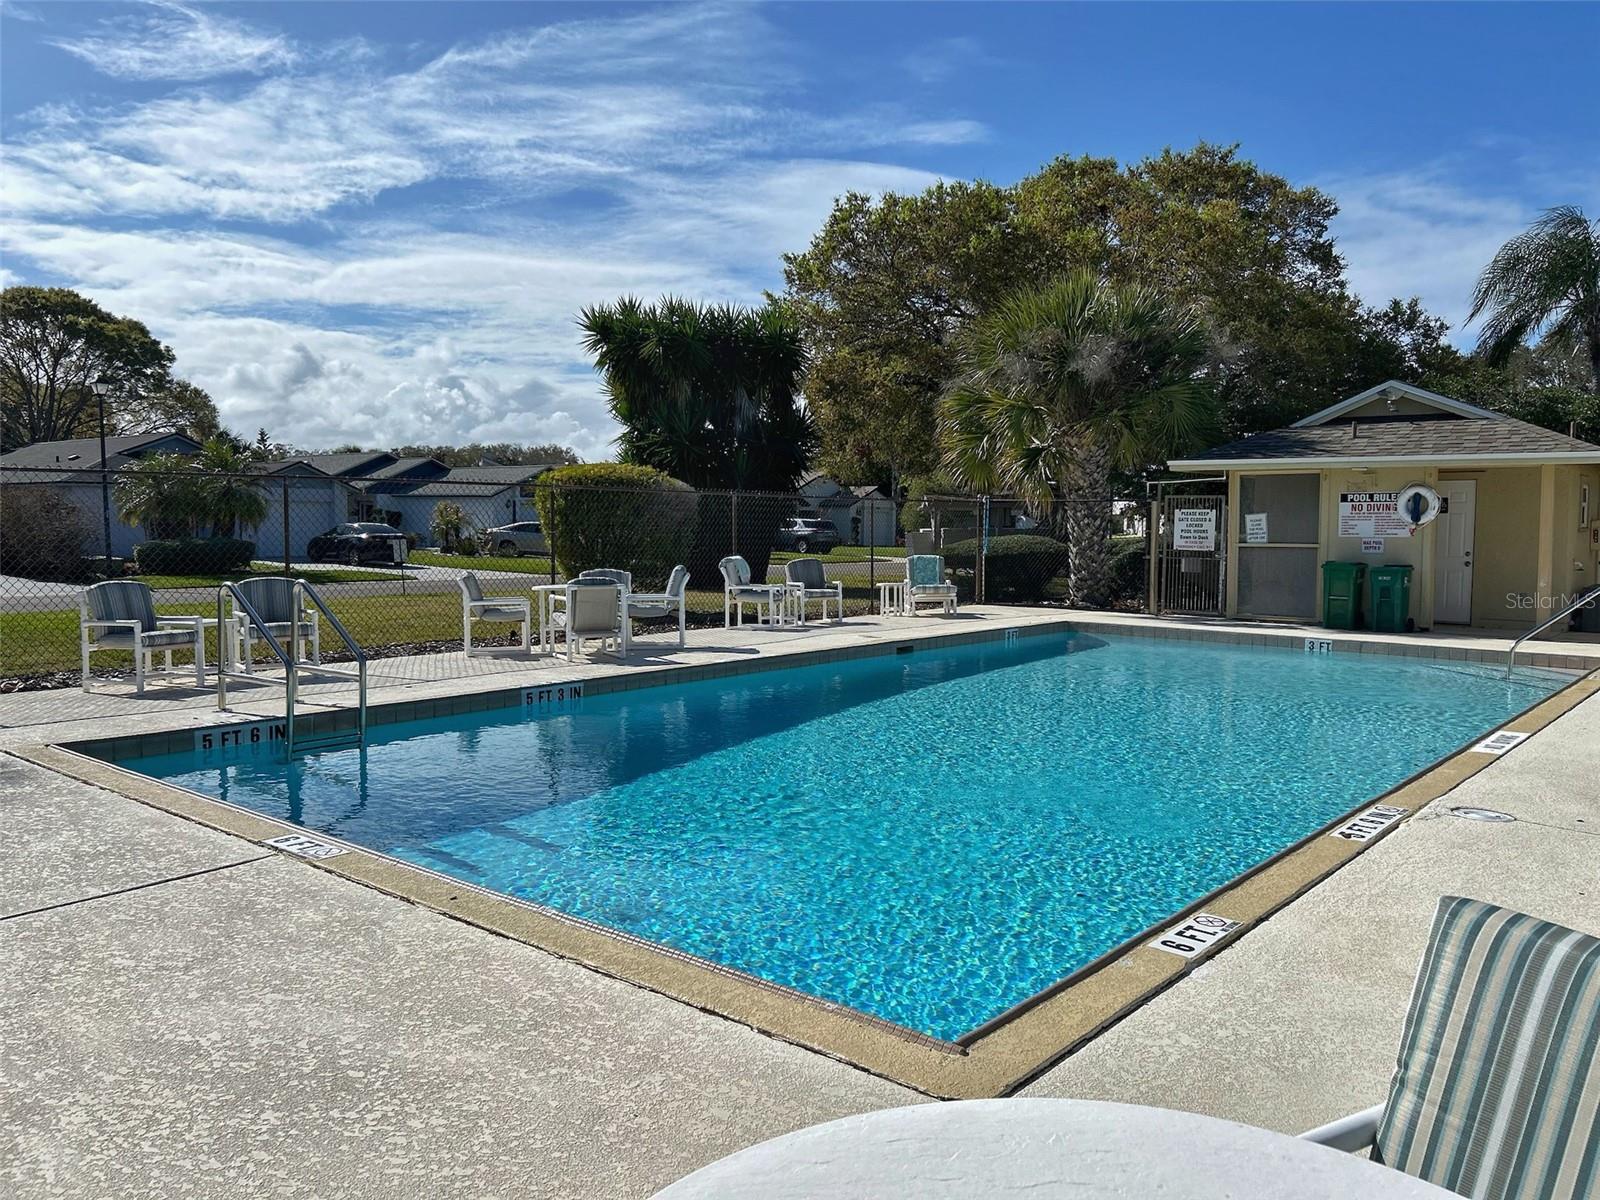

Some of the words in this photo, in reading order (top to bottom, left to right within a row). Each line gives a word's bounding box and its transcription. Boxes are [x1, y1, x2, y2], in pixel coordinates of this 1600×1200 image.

[1347, 494, 1371, 502] POOL
[1351, 503, 1364, 512] NO
[1366, 503, 1398, 512] DIVING
[1308, 641, 1315, 651] 3
[526, 692, 533, 705] 5
[558, 688, 565, 701] 3
[570, 686, 581, 699] IN
[202, 733, 212, 749] 5
[251, 727, 260, 743] 6
[269, 724, 287, 740] IN
[273, 836, 301, 844] 6
[1160, 940, 1196, 952] 6
